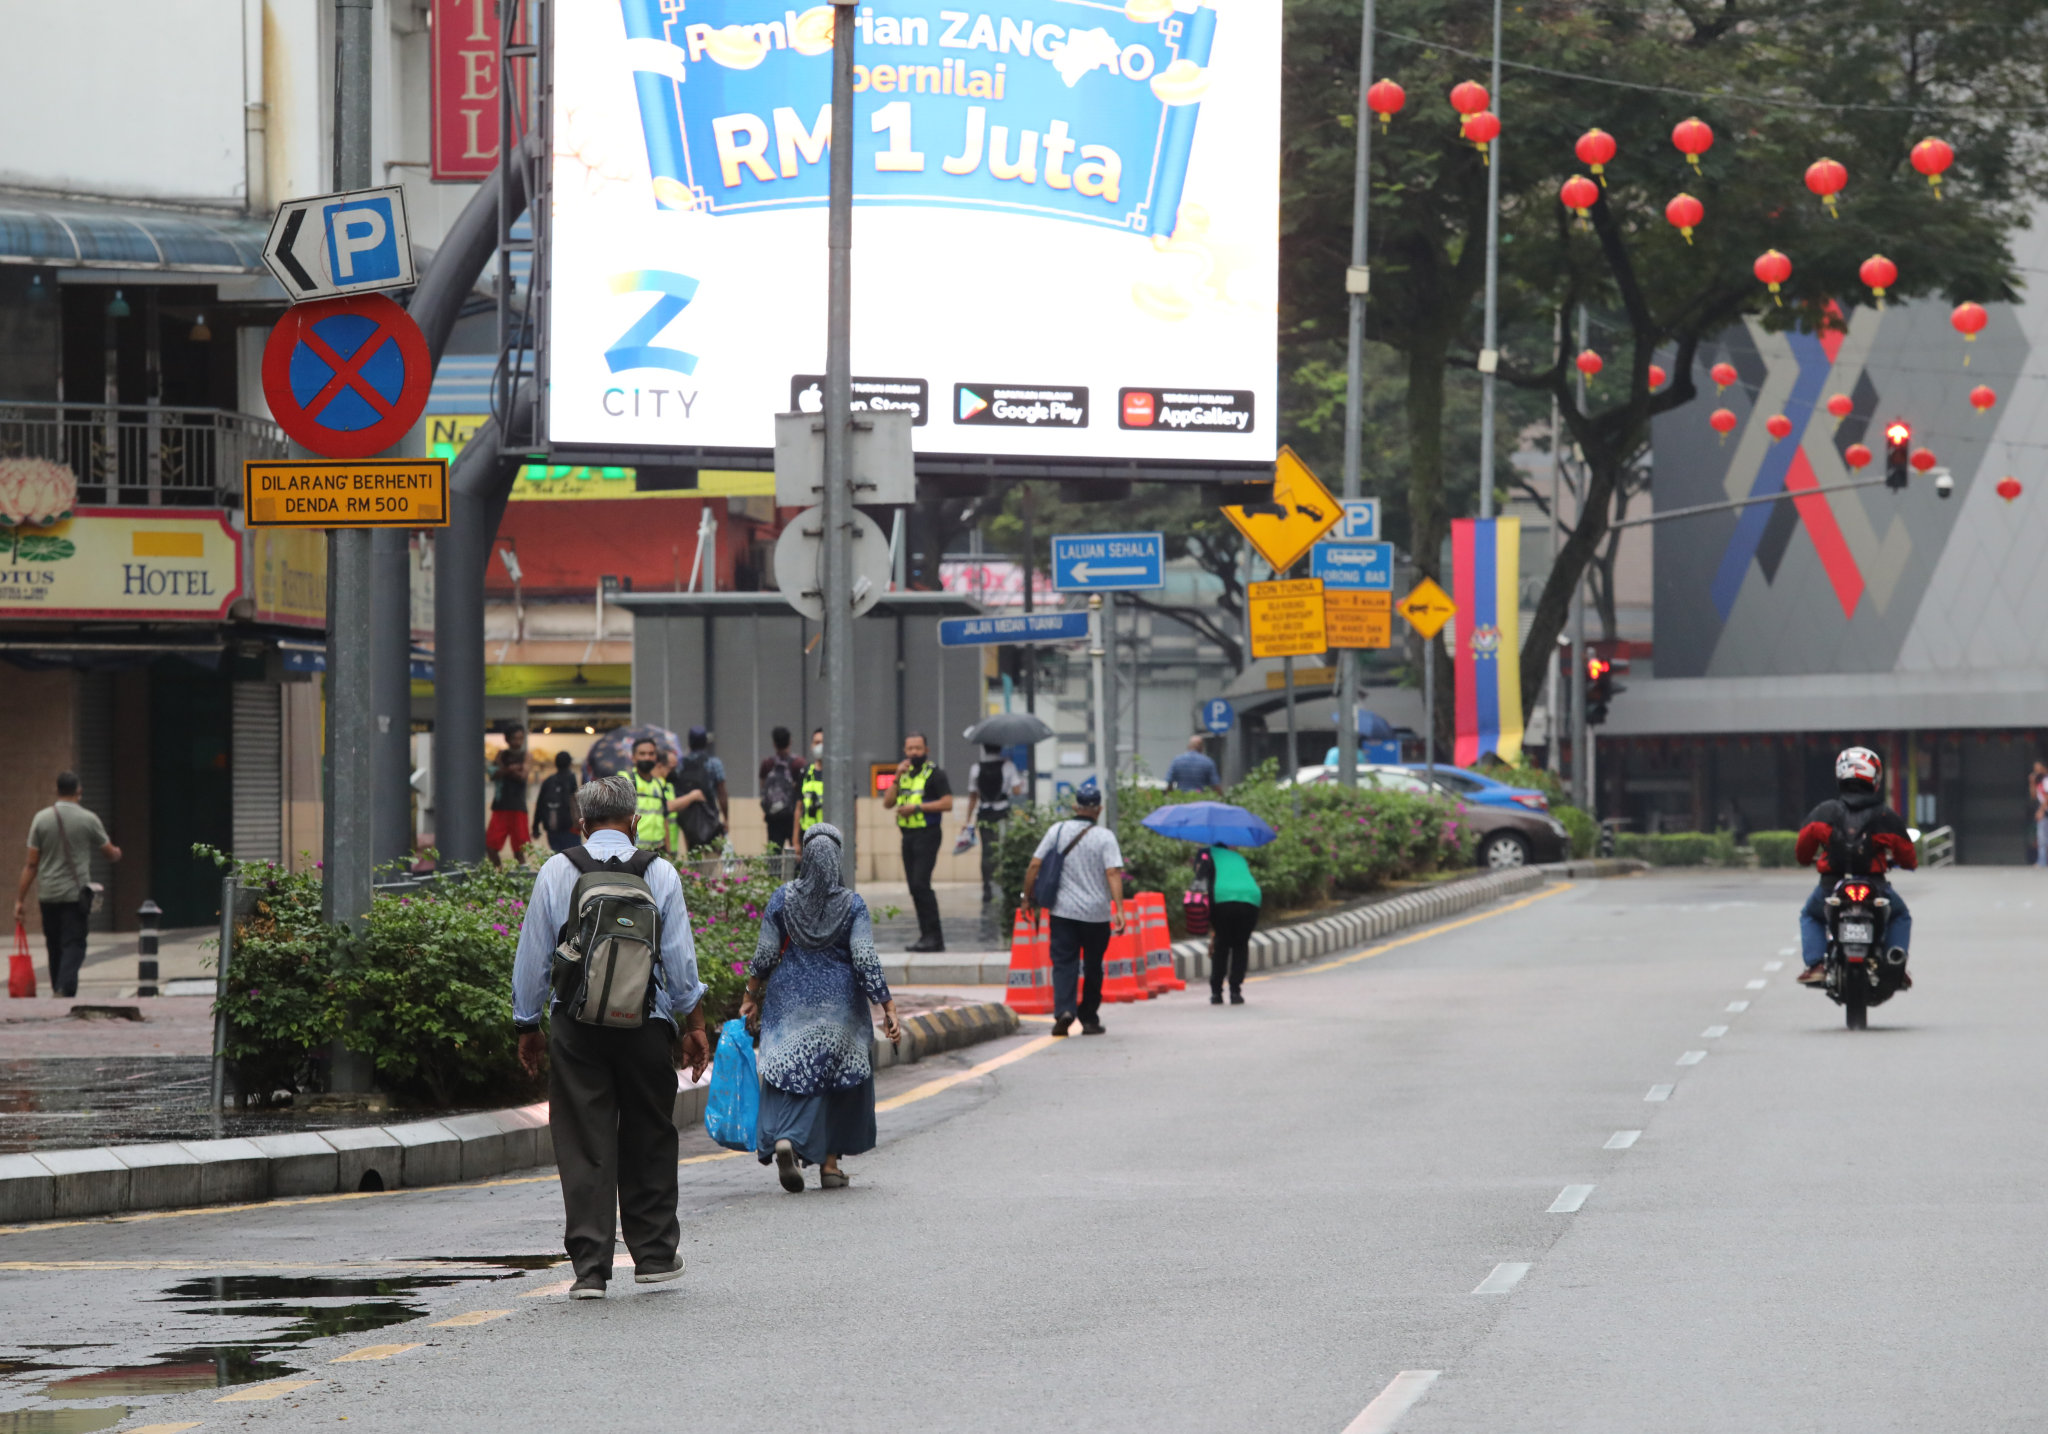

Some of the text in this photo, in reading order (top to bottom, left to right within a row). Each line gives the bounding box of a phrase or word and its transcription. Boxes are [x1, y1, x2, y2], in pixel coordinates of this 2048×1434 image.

[938, 10, 1155, 81] ZANGO
[712, 101, 1122, 203] RM 1 Juta
[332, 208, 386, 277] P
[602, 387, 698, 419] CITY
[992, 400, 1083, 424] Google Play
[1159, 406, 1249, 430] AppGallery
[262, 474, 432, 491] DILARANG BERHENTI
[286, 497, 408, 513] DENDA RM 500
[1345, 505, 1370, 536] P
[1059, 542, 1155, 559] LALUAN SEHALA
[122, 564, 215, 596] HOTEL
[964, 620, 993, 635] JALAN
[995, 618, 1026, 633] MEDAN
[1212, 701, 1226, 720] P
